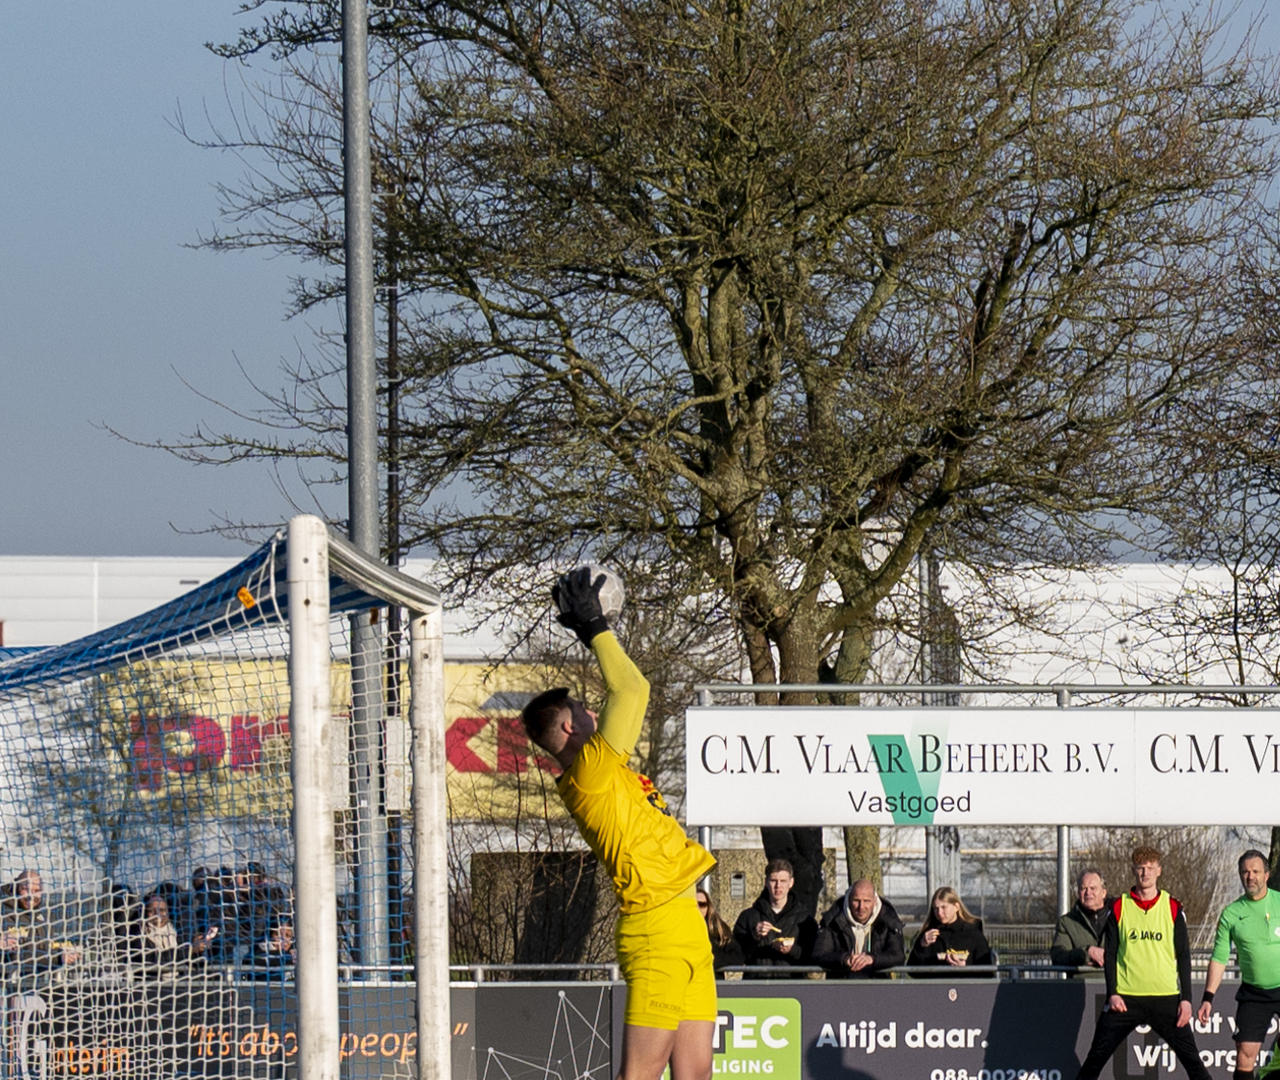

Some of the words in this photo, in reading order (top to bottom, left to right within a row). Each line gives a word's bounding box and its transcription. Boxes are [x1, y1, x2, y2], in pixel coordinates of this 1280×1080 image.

[701, 735, 780, 774] C.M.
[1065, 743, 1119, 774] B.V.
[1150, 735, 1229, 774] C.M.
[849, 790, 971, 818] Vastgoed
[1140, 930, 1163, 941] JAKO
[817, 1021, 897, 1054] Altijd
[905, 1021, 989, 1049] daar.
[1133, 1043, 1177, 1073] Wij
